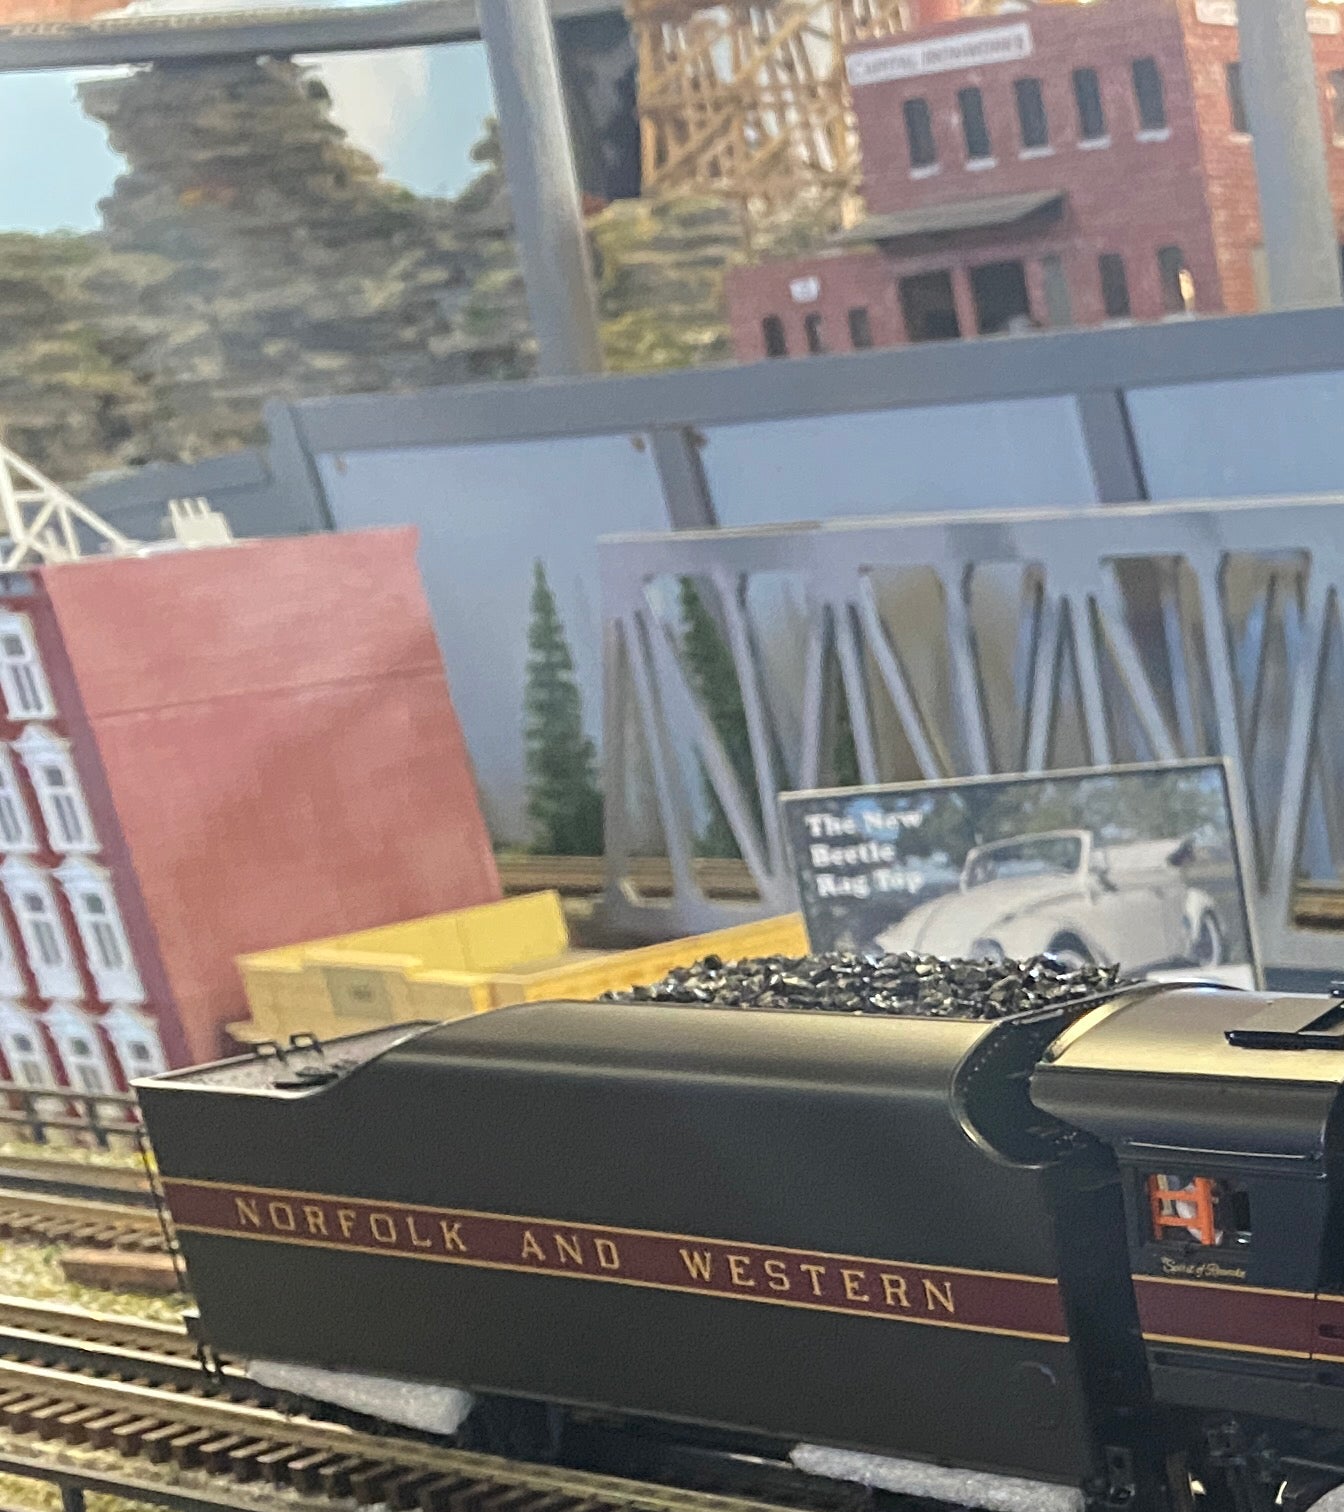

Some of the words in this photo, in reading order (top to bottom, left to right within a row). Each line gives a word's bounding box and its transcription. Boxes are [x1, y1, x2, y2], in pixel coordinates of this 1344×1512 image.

[805, 813, 856, 837] The
[862, 810, 924, 833] New
[810, 842, 896, 868] Beetle
[816, 874, 871, 899] Rag
[873, 868, 925, 895] Top
[235, 1198, 468, 1252] NORFOLK
[521, 1230, 621, 1271] AND
[679, 1247, 956, 1314] WESTERN
